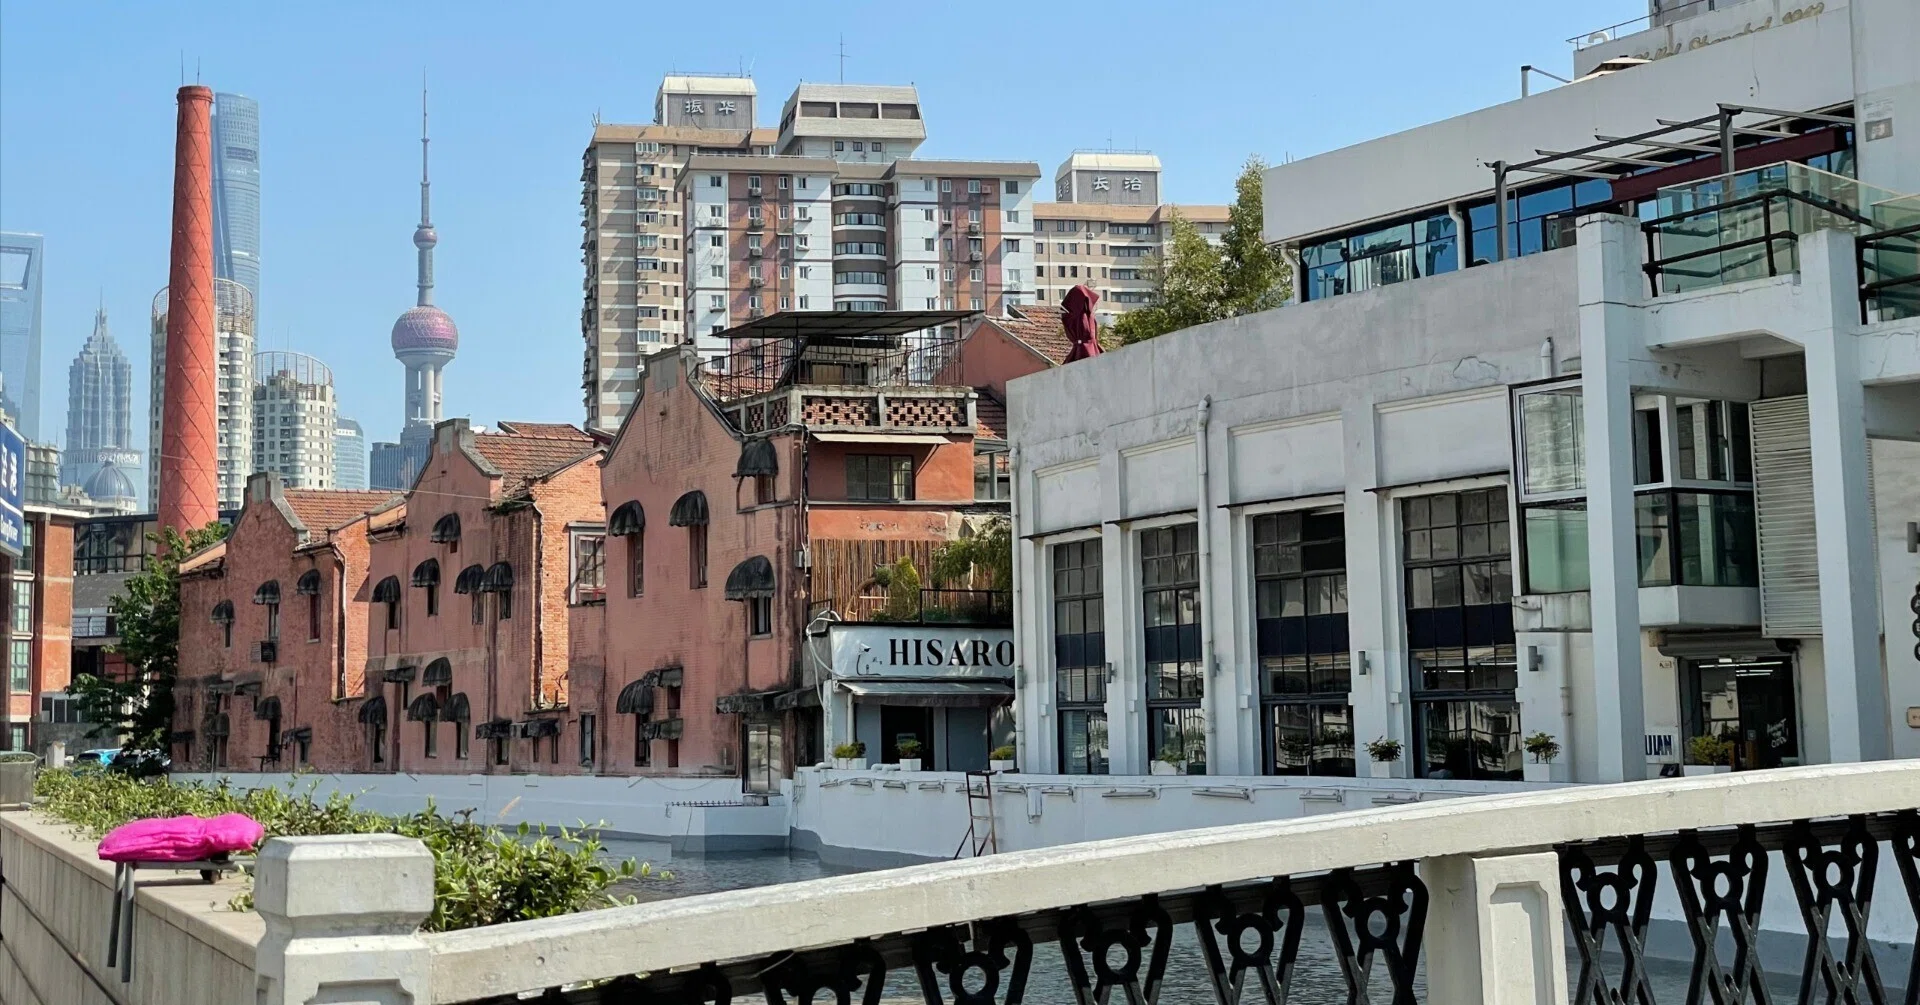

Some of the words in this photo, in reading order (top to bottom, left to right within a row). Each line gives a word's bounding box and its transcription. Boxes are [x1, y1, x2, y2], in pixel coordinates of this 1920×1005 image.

[685, 99, 736, 115] 振华
[1093, 176, 1141, 191] 长治
[889, 638, 1014, 667] HISARO
